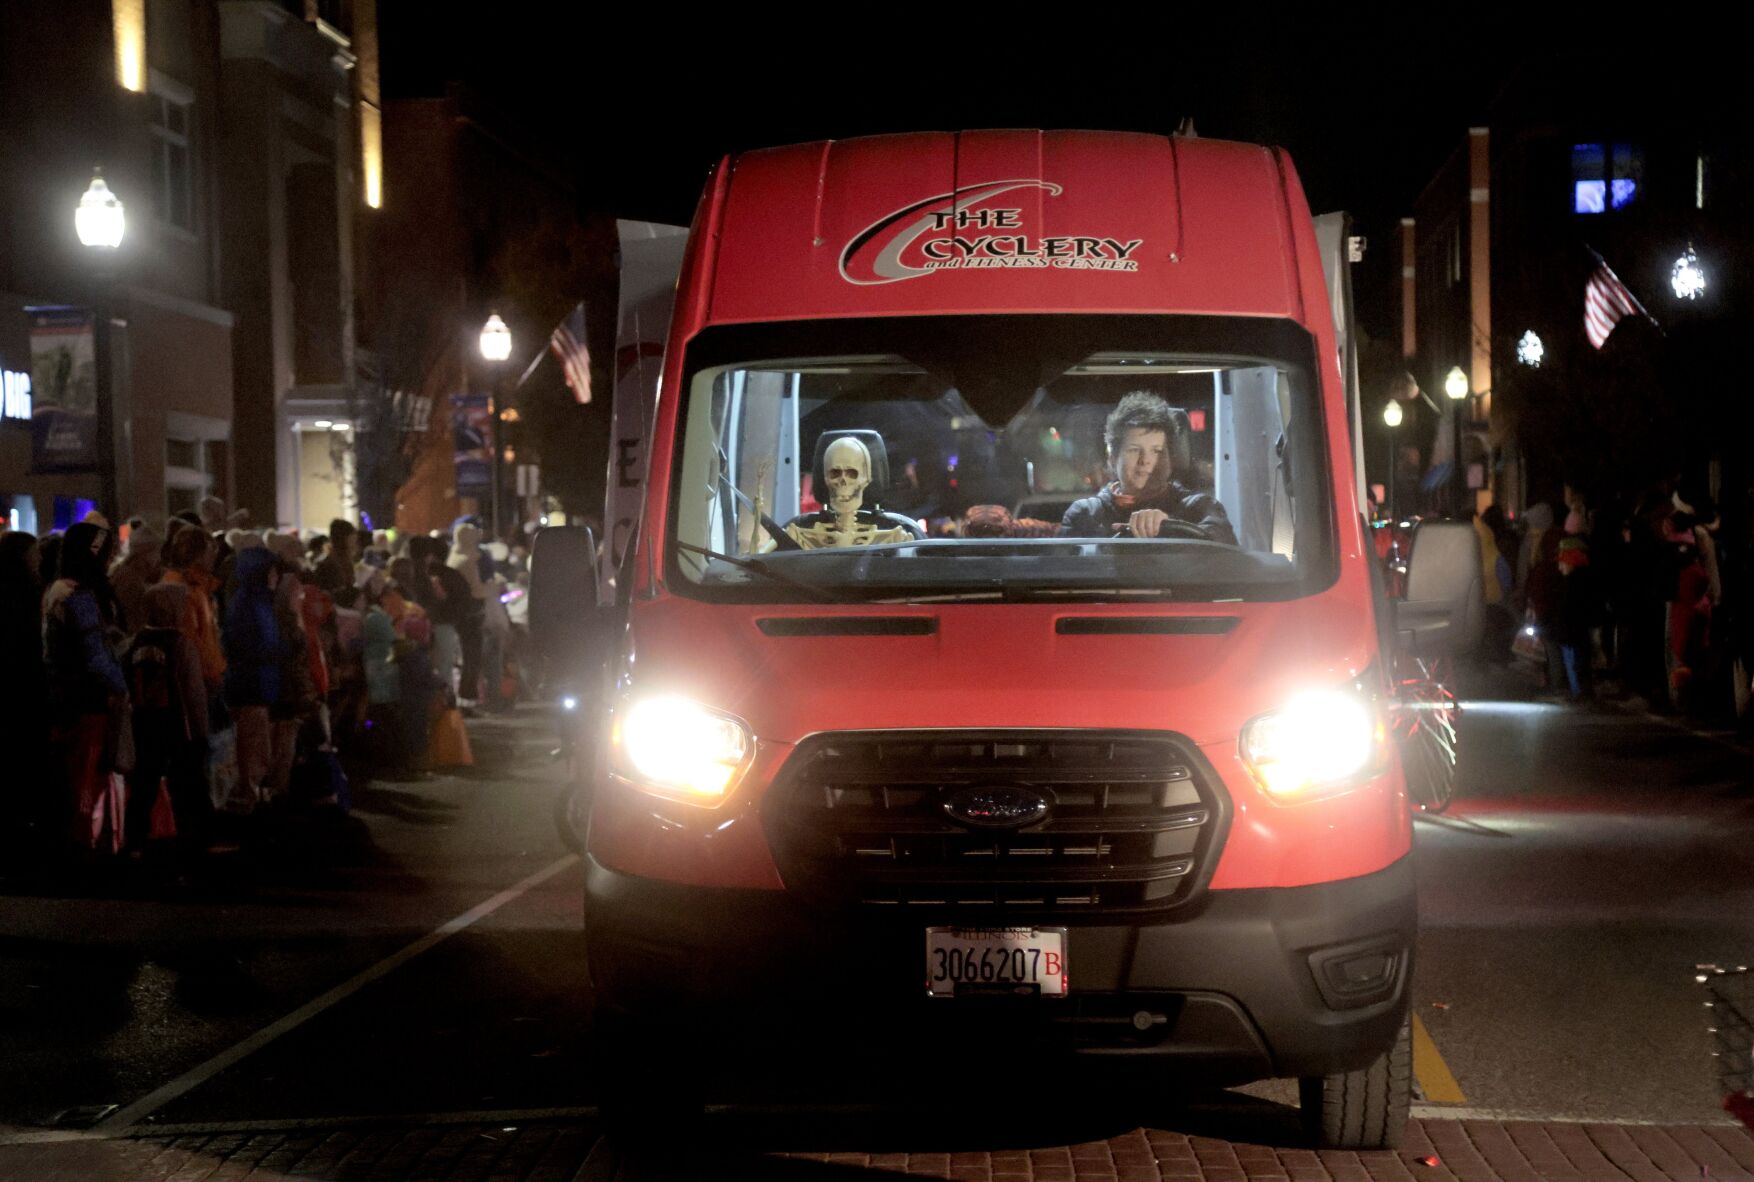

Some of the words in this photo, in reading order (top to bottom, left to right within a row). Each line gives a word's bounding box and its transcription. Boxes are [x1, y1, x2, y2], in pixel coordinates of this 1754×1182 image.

[927, 207, 1023, 230] THE
[922, 234, 1144, 260] CYCLERY
[925, 256, 961, 269] and
[962, 256, 1049, 269] FITNESS
[1052, 256, 1139, 272] CENTER
[933, 947, 1041, 982] 3066207
[1045, 952, 1062, 976] B
